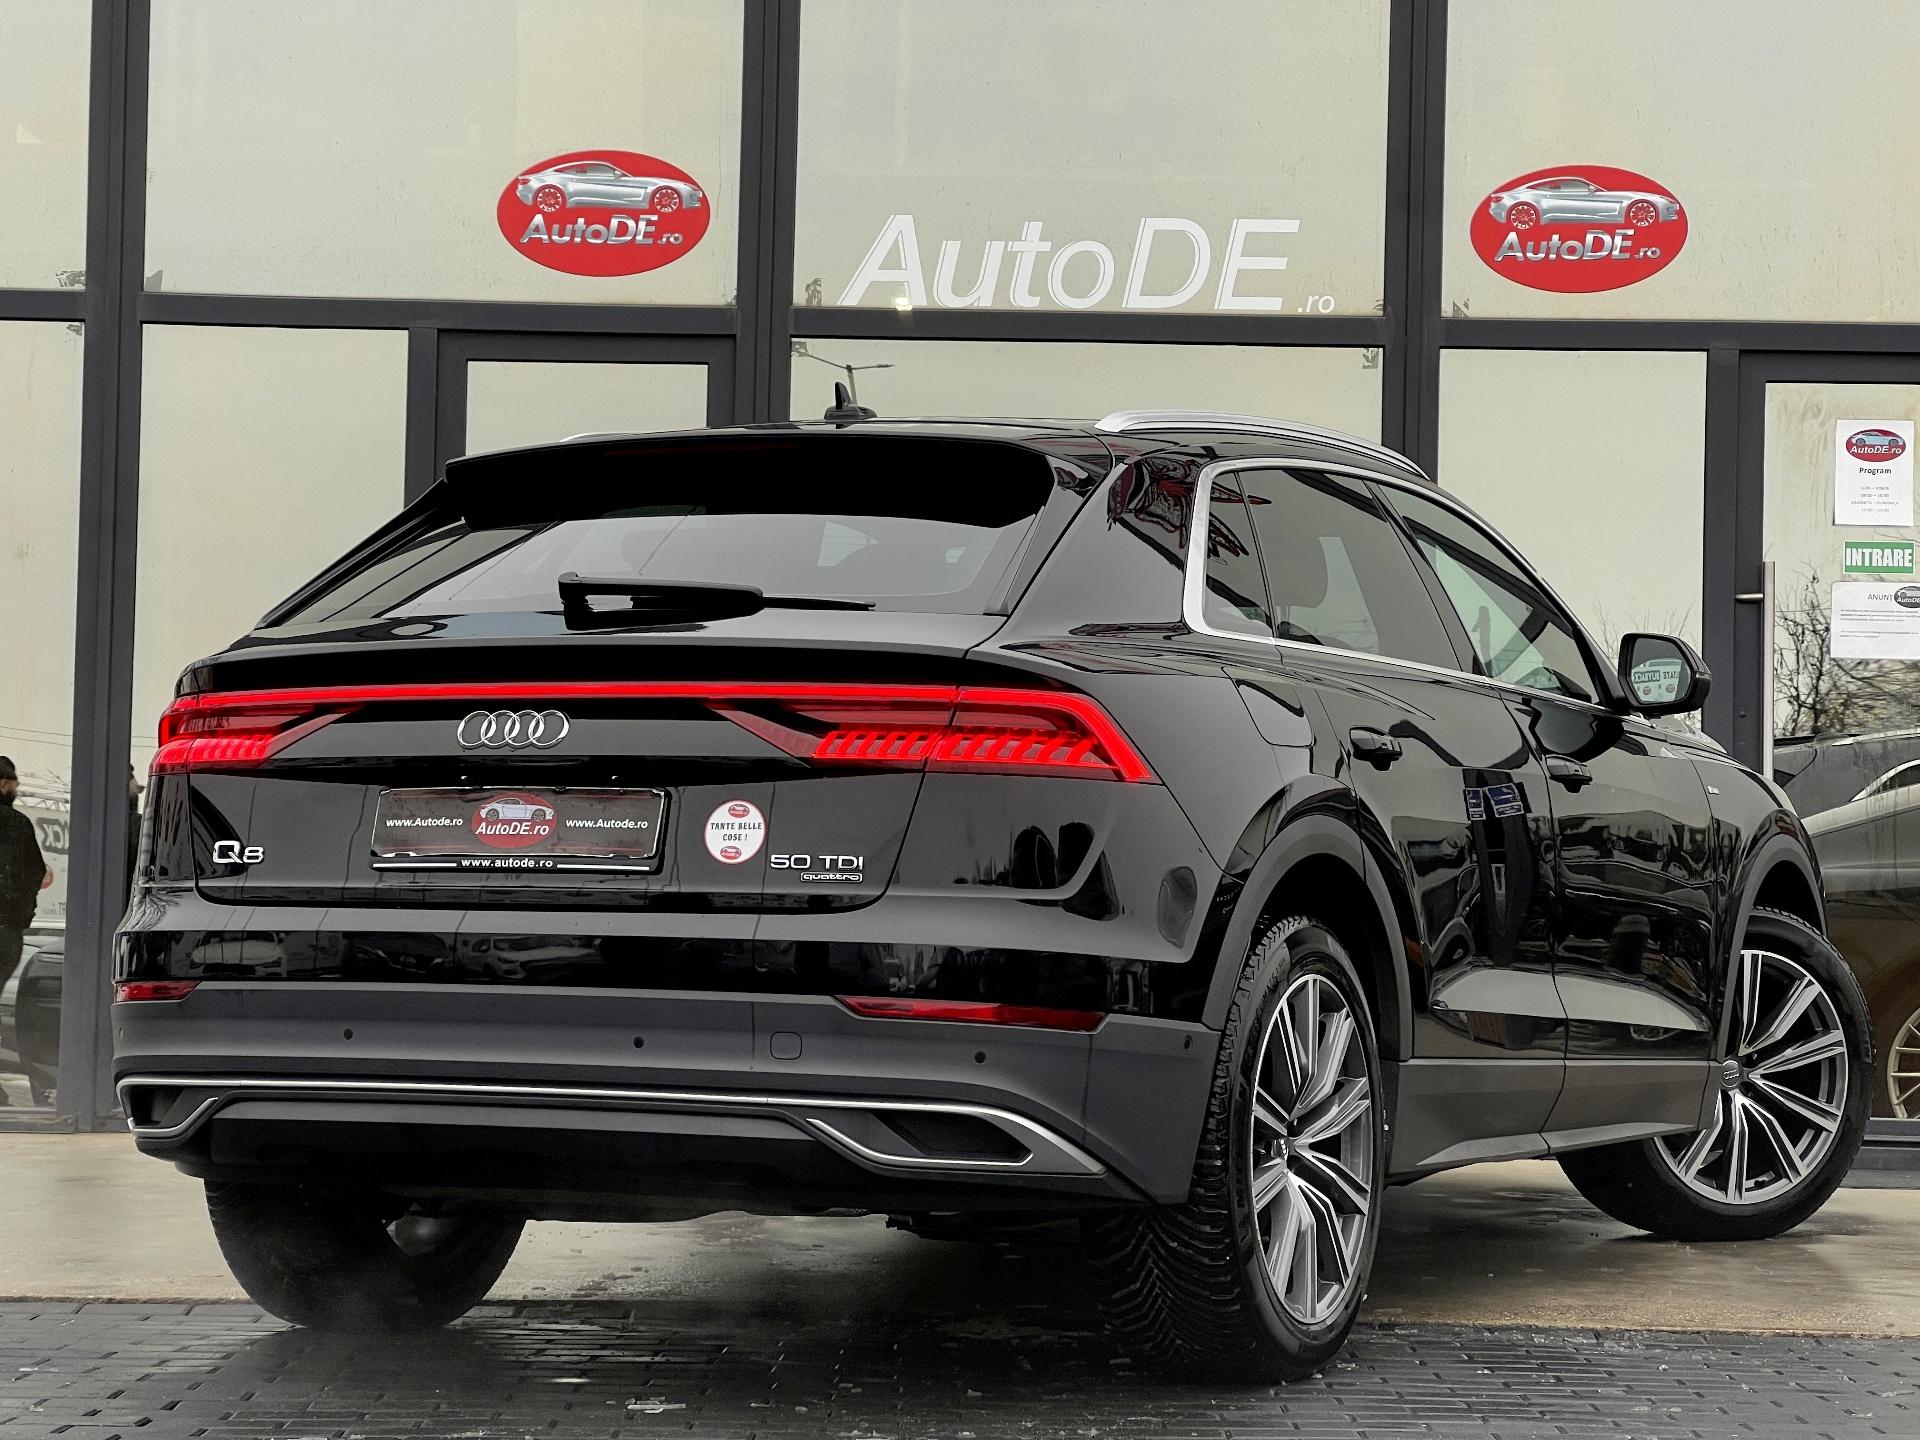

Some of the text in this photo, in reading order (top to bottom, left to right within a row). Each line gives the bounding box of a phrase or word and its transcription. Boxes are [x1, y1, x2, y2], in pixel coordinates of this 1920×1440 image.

[519, 213, 684, 245] AutoDE.ro
[1494, 228, 1661, 262] AutoDE.ro
[1850, 445, 1902, 454] AutoDE.ro
[1859, 467, 1892, 475] Program
[1845, 548, 1912, 567] INTRARE
[386, 817, 463, 827] www.Autode.ro
[565, 817, 649, 829] www.Autode.ro
[710, 822, 763, 830] TANTE BELLE
[475, 821, 549, 836] AutoDE.ro
[722, 833, 743, 841] COSE
[213, 840, 264, 863] Q8
[461, 858, 553, 868] www.autode.ro
[770, 854, 865, 870] 50 TDI
[802, 873, 860, 882] quattro
